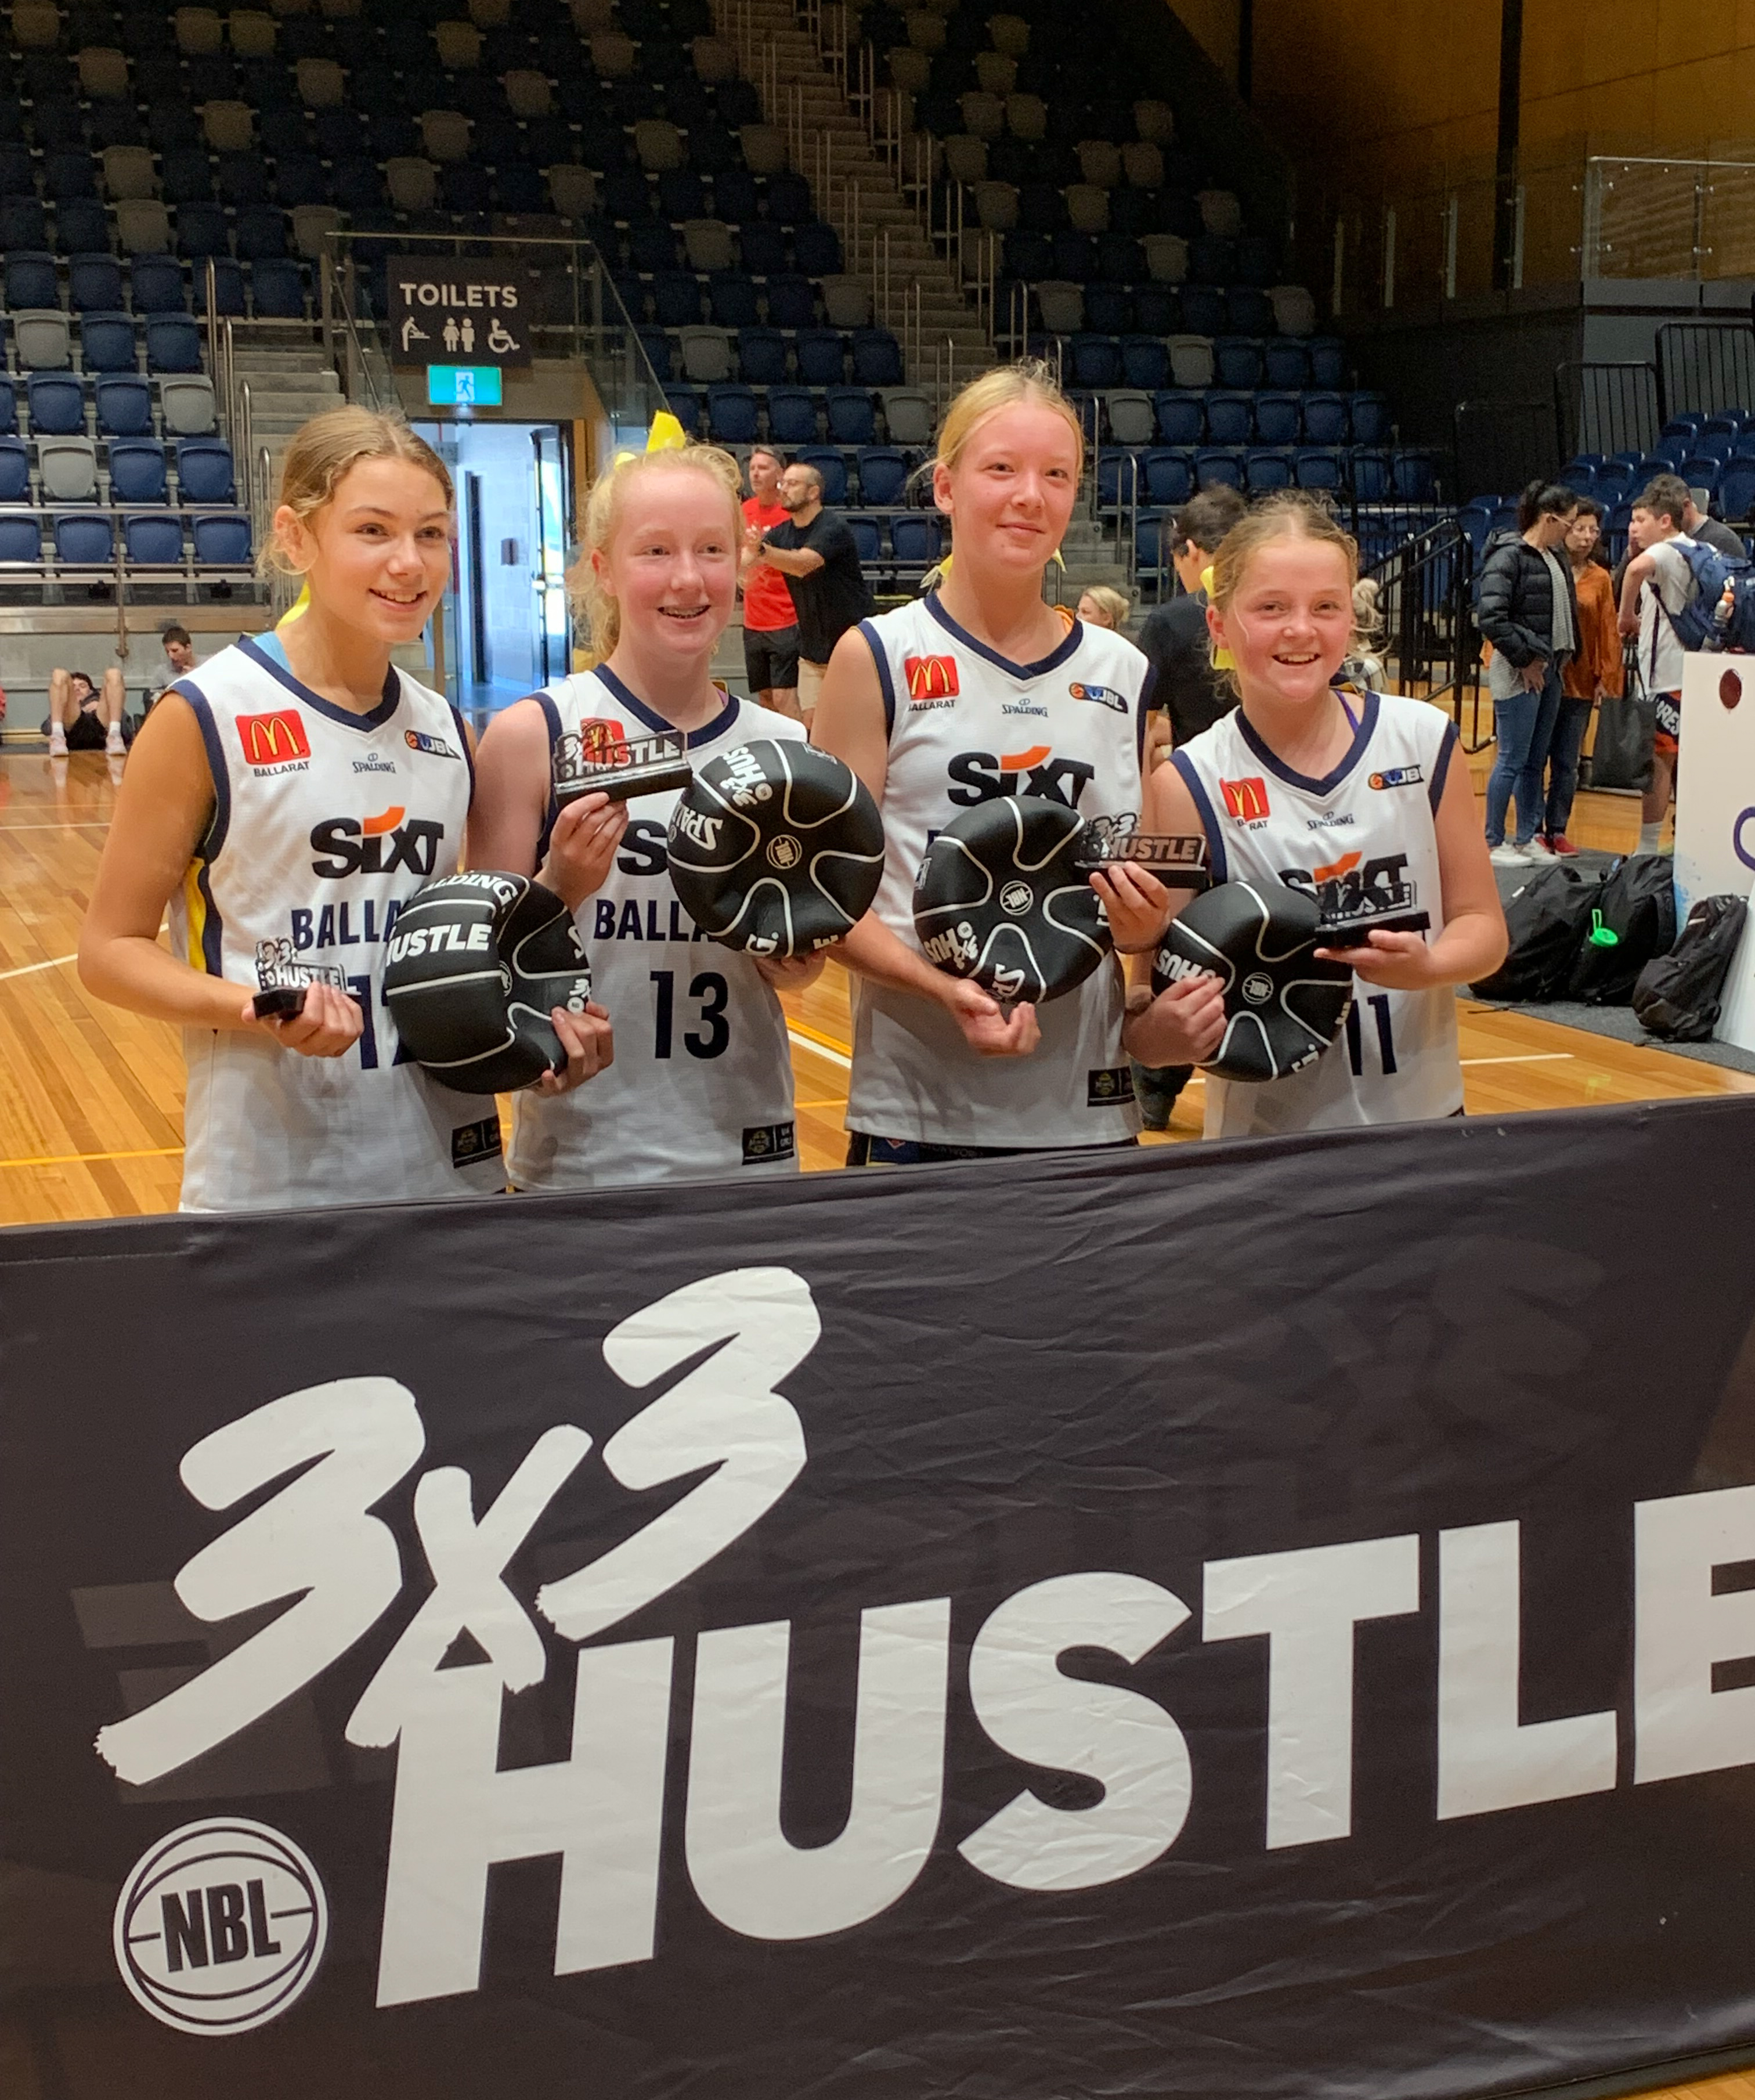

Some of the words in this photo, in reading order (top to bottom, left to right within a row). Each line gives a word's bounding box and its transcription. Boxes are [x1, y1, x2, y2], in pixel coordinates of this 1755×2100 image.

[400, 283, 518, 308] TOILETS
[908, 699, 956, 712] ALLARAT
[1002, 704, 1049, 717] SPALDING
[254, 761, 310, 777] BALLARAT
[352, 762, 396, 774] SPALDING
[649, 970, 730, 1059] 13
[375, 1486, 1755, 2008] HUSTLE
[161, 1878, 281, 1973] NBL
